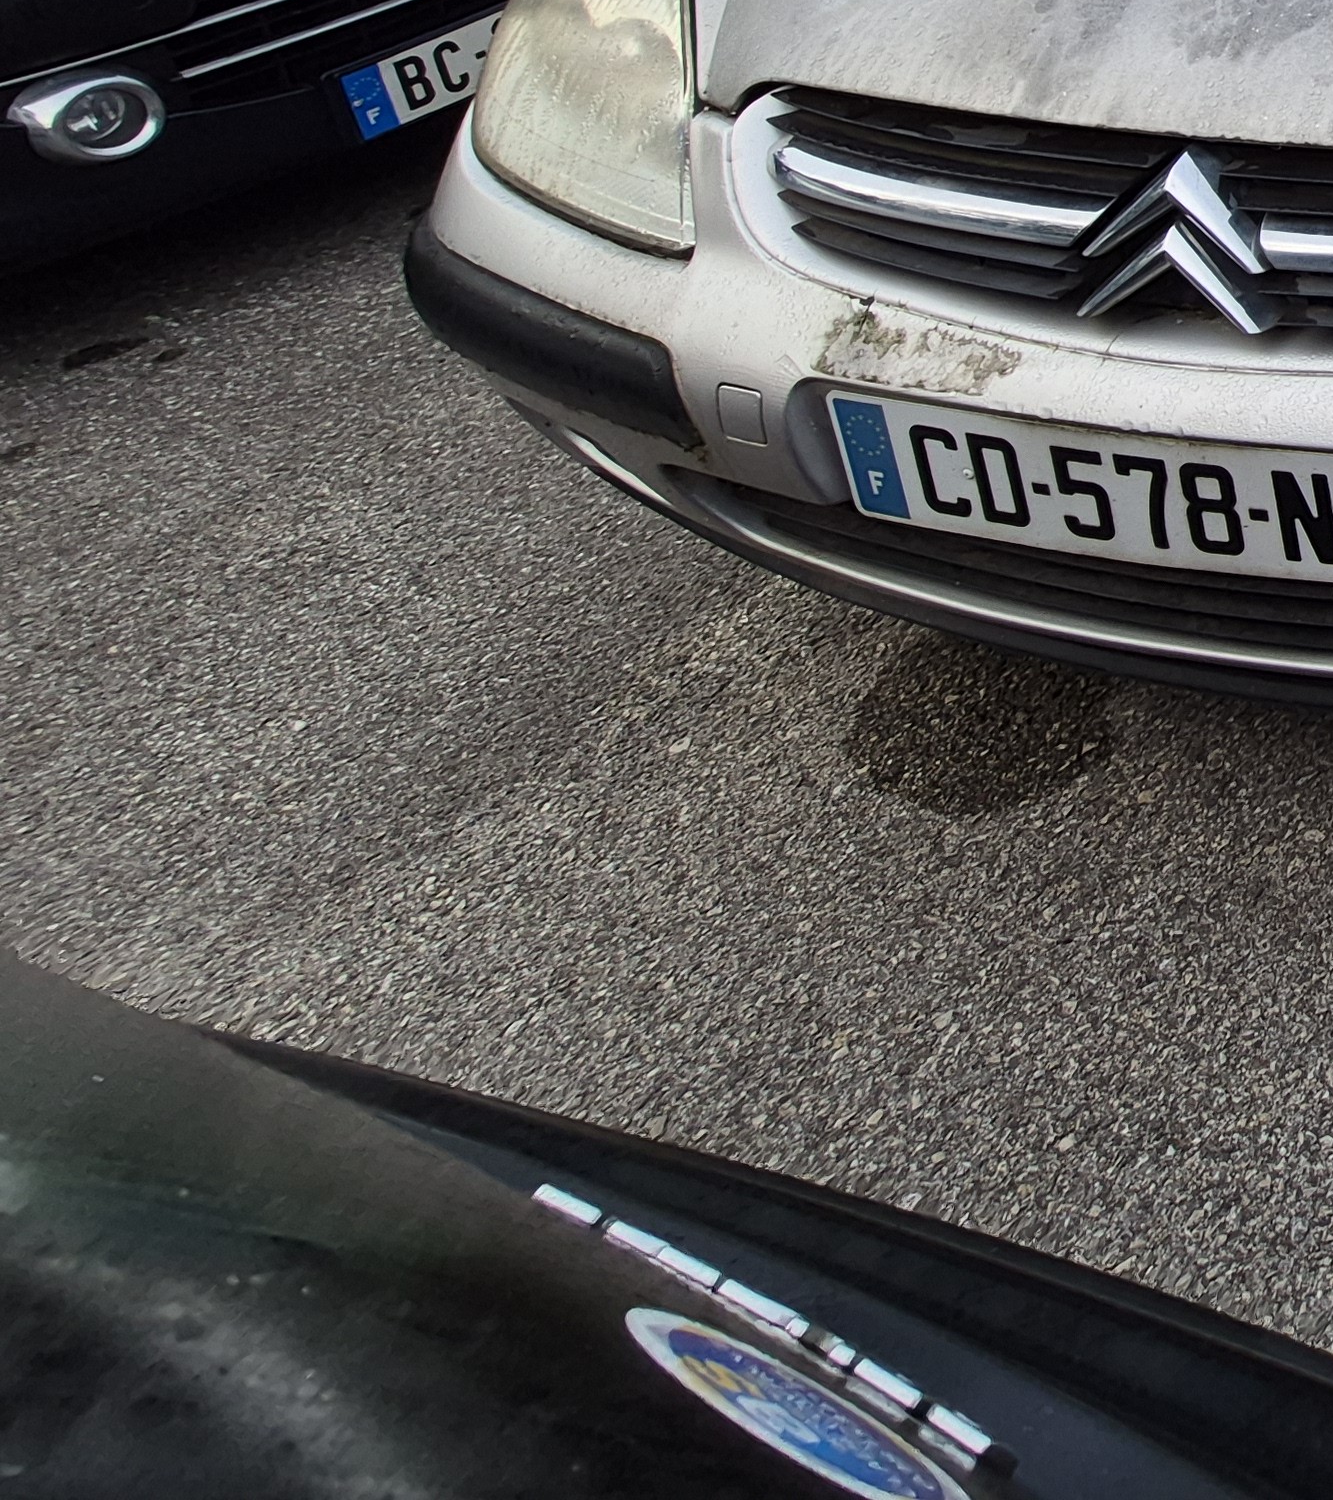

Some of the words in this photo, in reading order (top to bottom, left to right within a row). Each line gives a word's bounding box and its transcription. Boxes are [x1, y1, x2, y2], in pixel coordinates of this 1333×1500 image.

[393, 17, 502, 111] BC-
[366, 106, 381, 126] F
[868, 470, 884, 495] F
